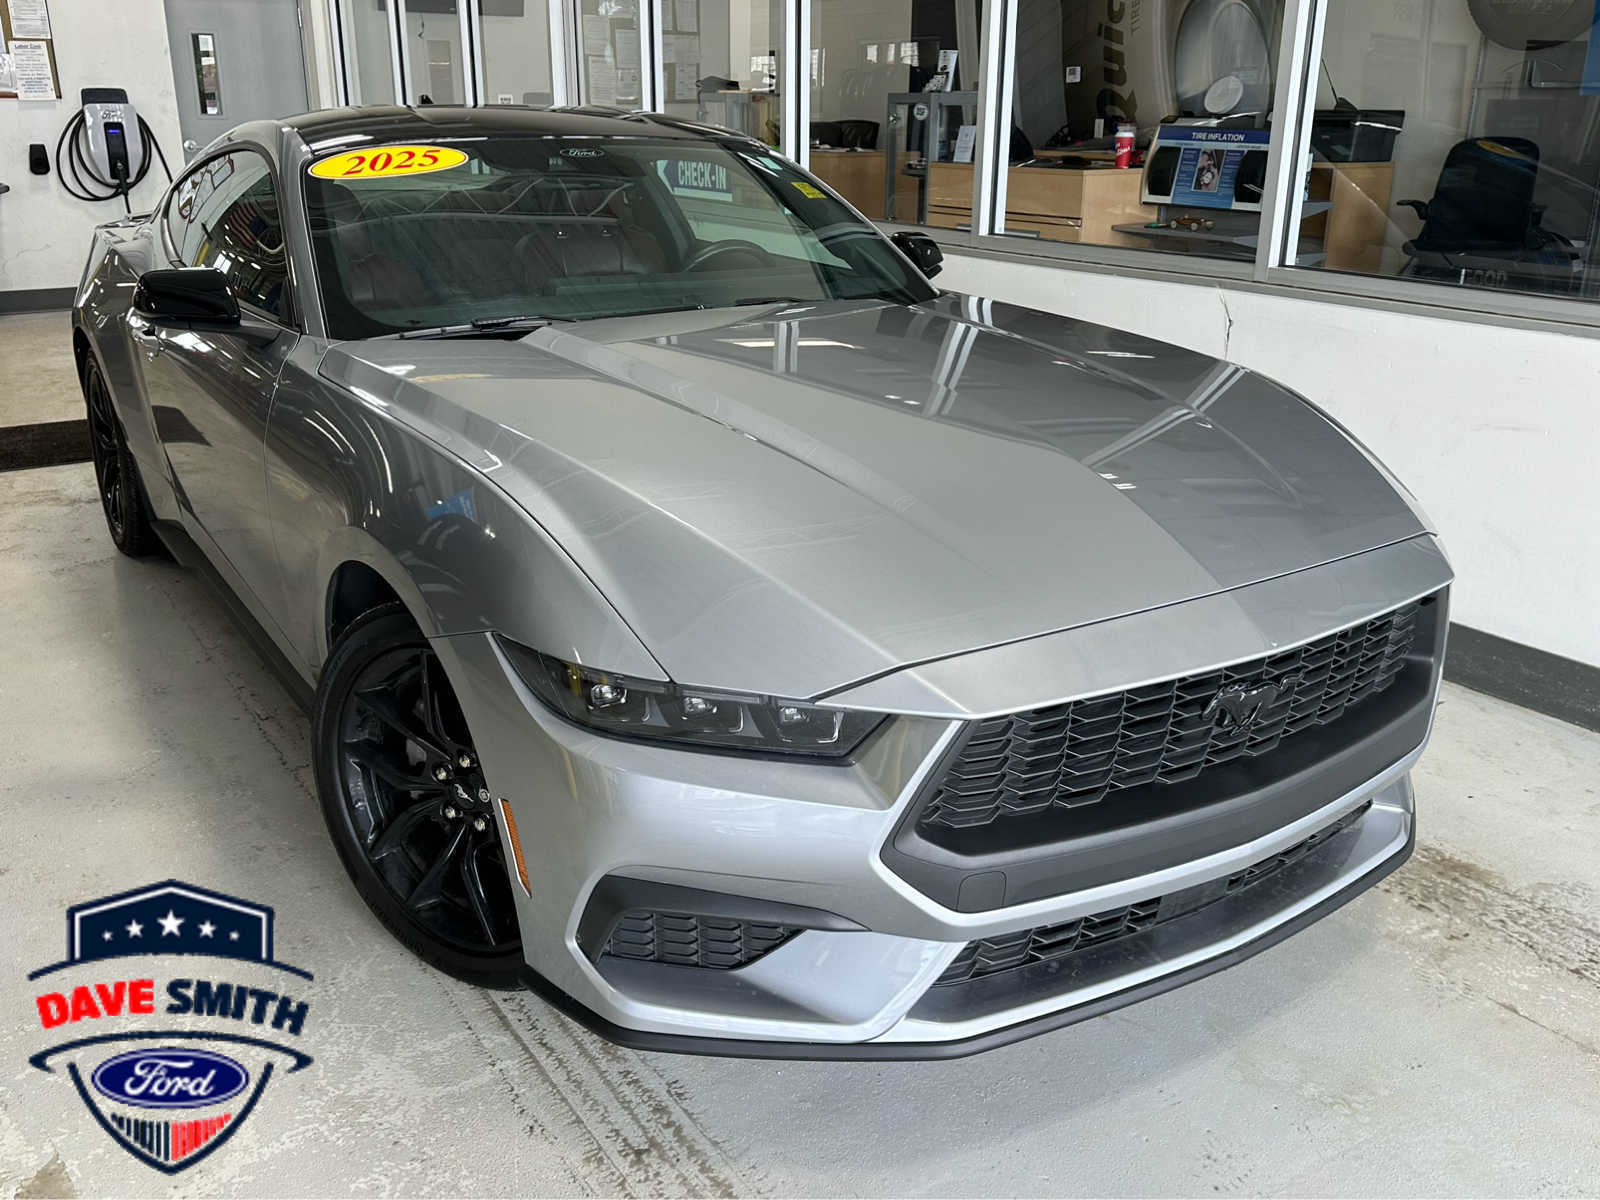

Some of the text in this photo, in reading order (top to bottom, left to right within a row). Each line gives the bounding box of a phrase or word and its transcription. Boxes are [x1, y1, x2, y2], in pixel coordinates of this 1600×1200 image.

[1192, 132, 1245, 141] TIRE INFLATION
[342, 149, 440, 175] 2025
[678, 160, 726, 190] CHECK-IN
